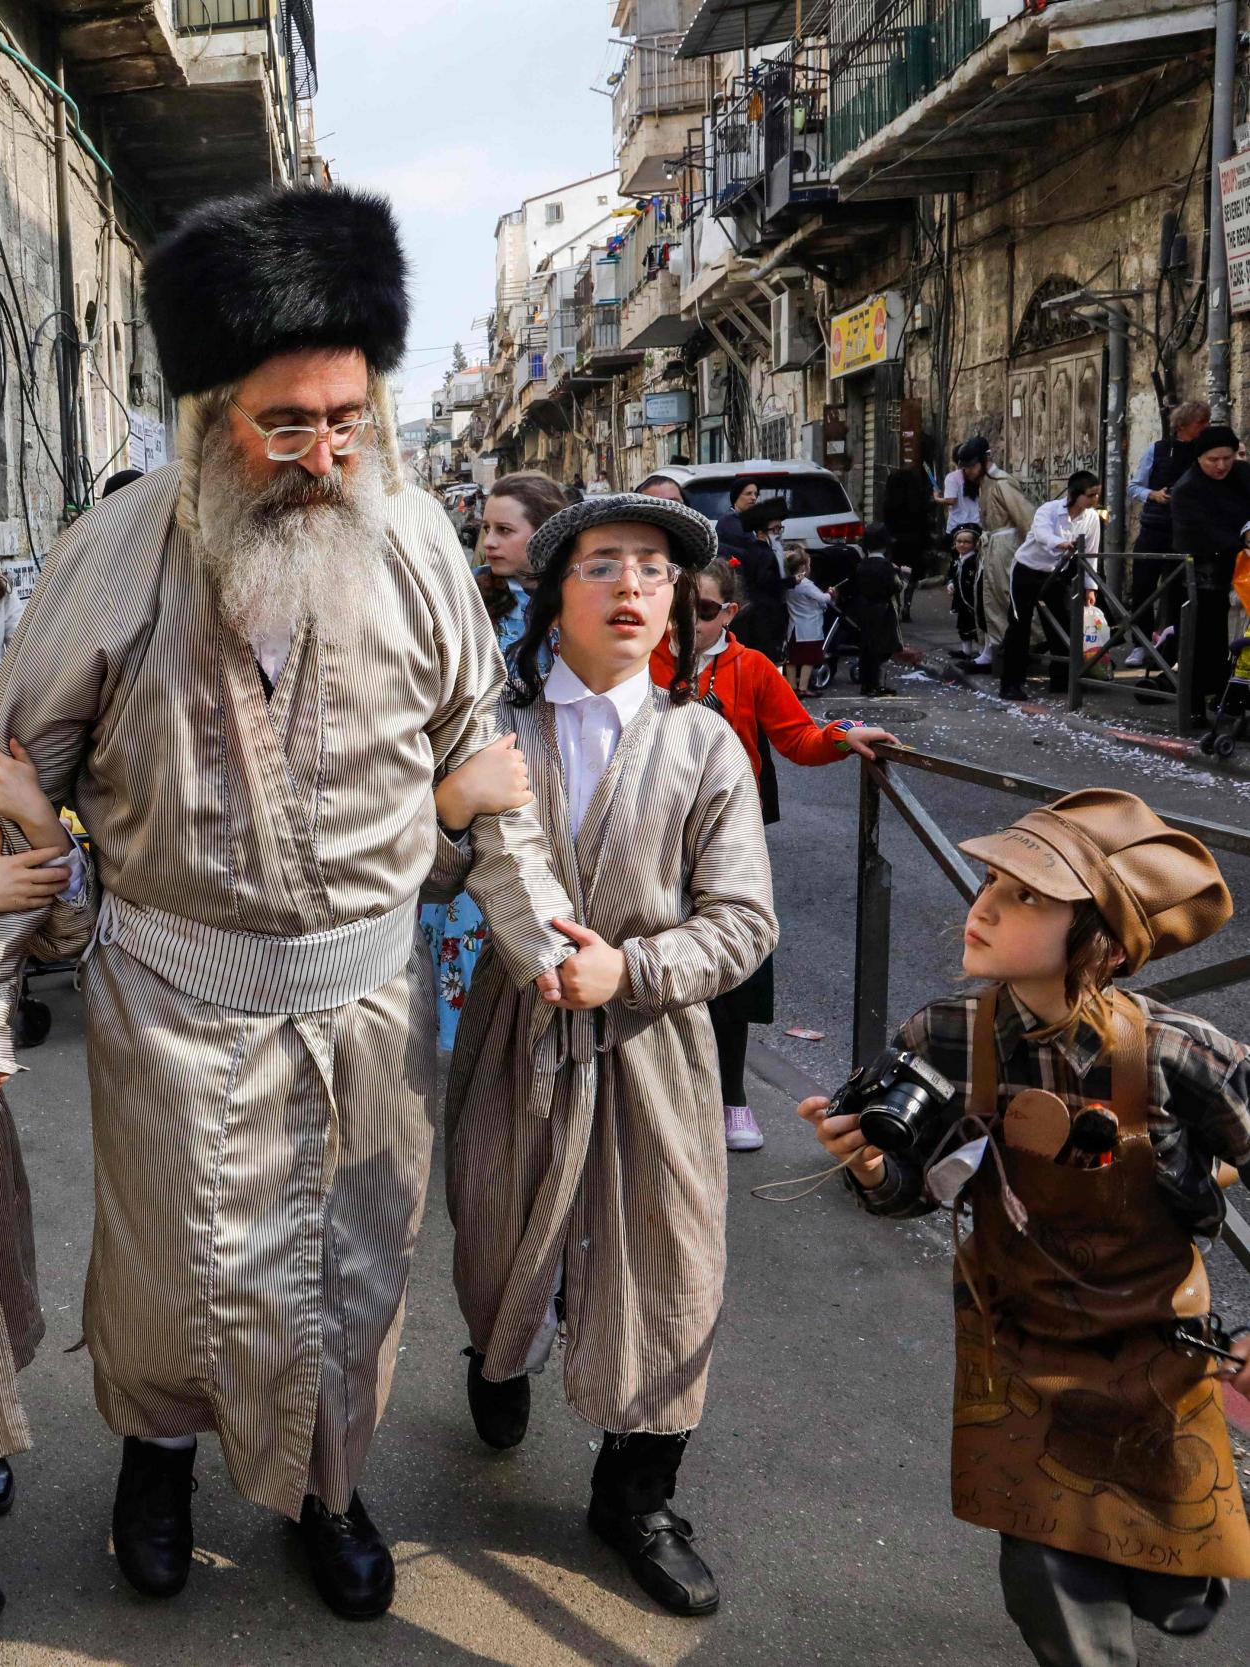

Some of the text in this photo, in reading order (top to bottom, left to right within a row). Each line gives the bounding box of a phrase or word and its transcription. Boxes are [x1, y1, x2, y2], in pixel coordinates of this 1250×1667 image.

[1223, 197, 1245, 223] SEVERELY
[1226, 224, 1250, 250] THE RESID
